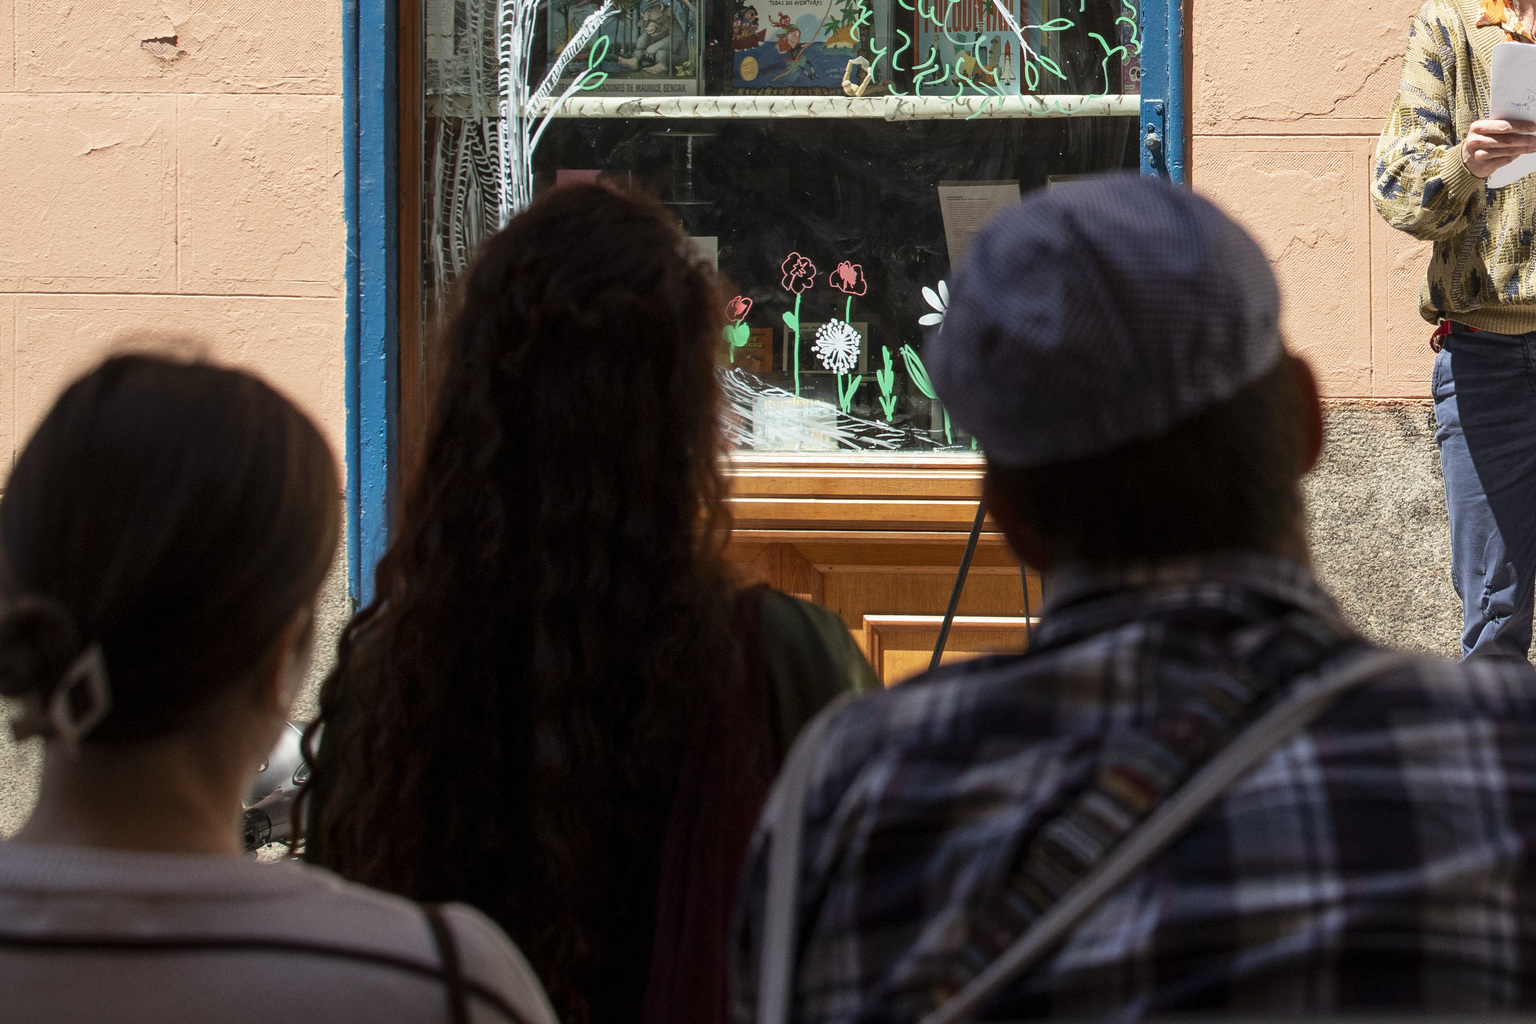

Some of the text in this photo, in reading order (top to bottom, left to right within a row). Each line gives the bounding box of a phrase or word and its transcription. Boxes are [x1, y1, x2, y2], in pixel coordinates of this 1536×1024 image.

[626, 83, 634, 93] DE
[636, 83, 660, 93] MAURICE
[663, 83, 687, 93] SENDAK
